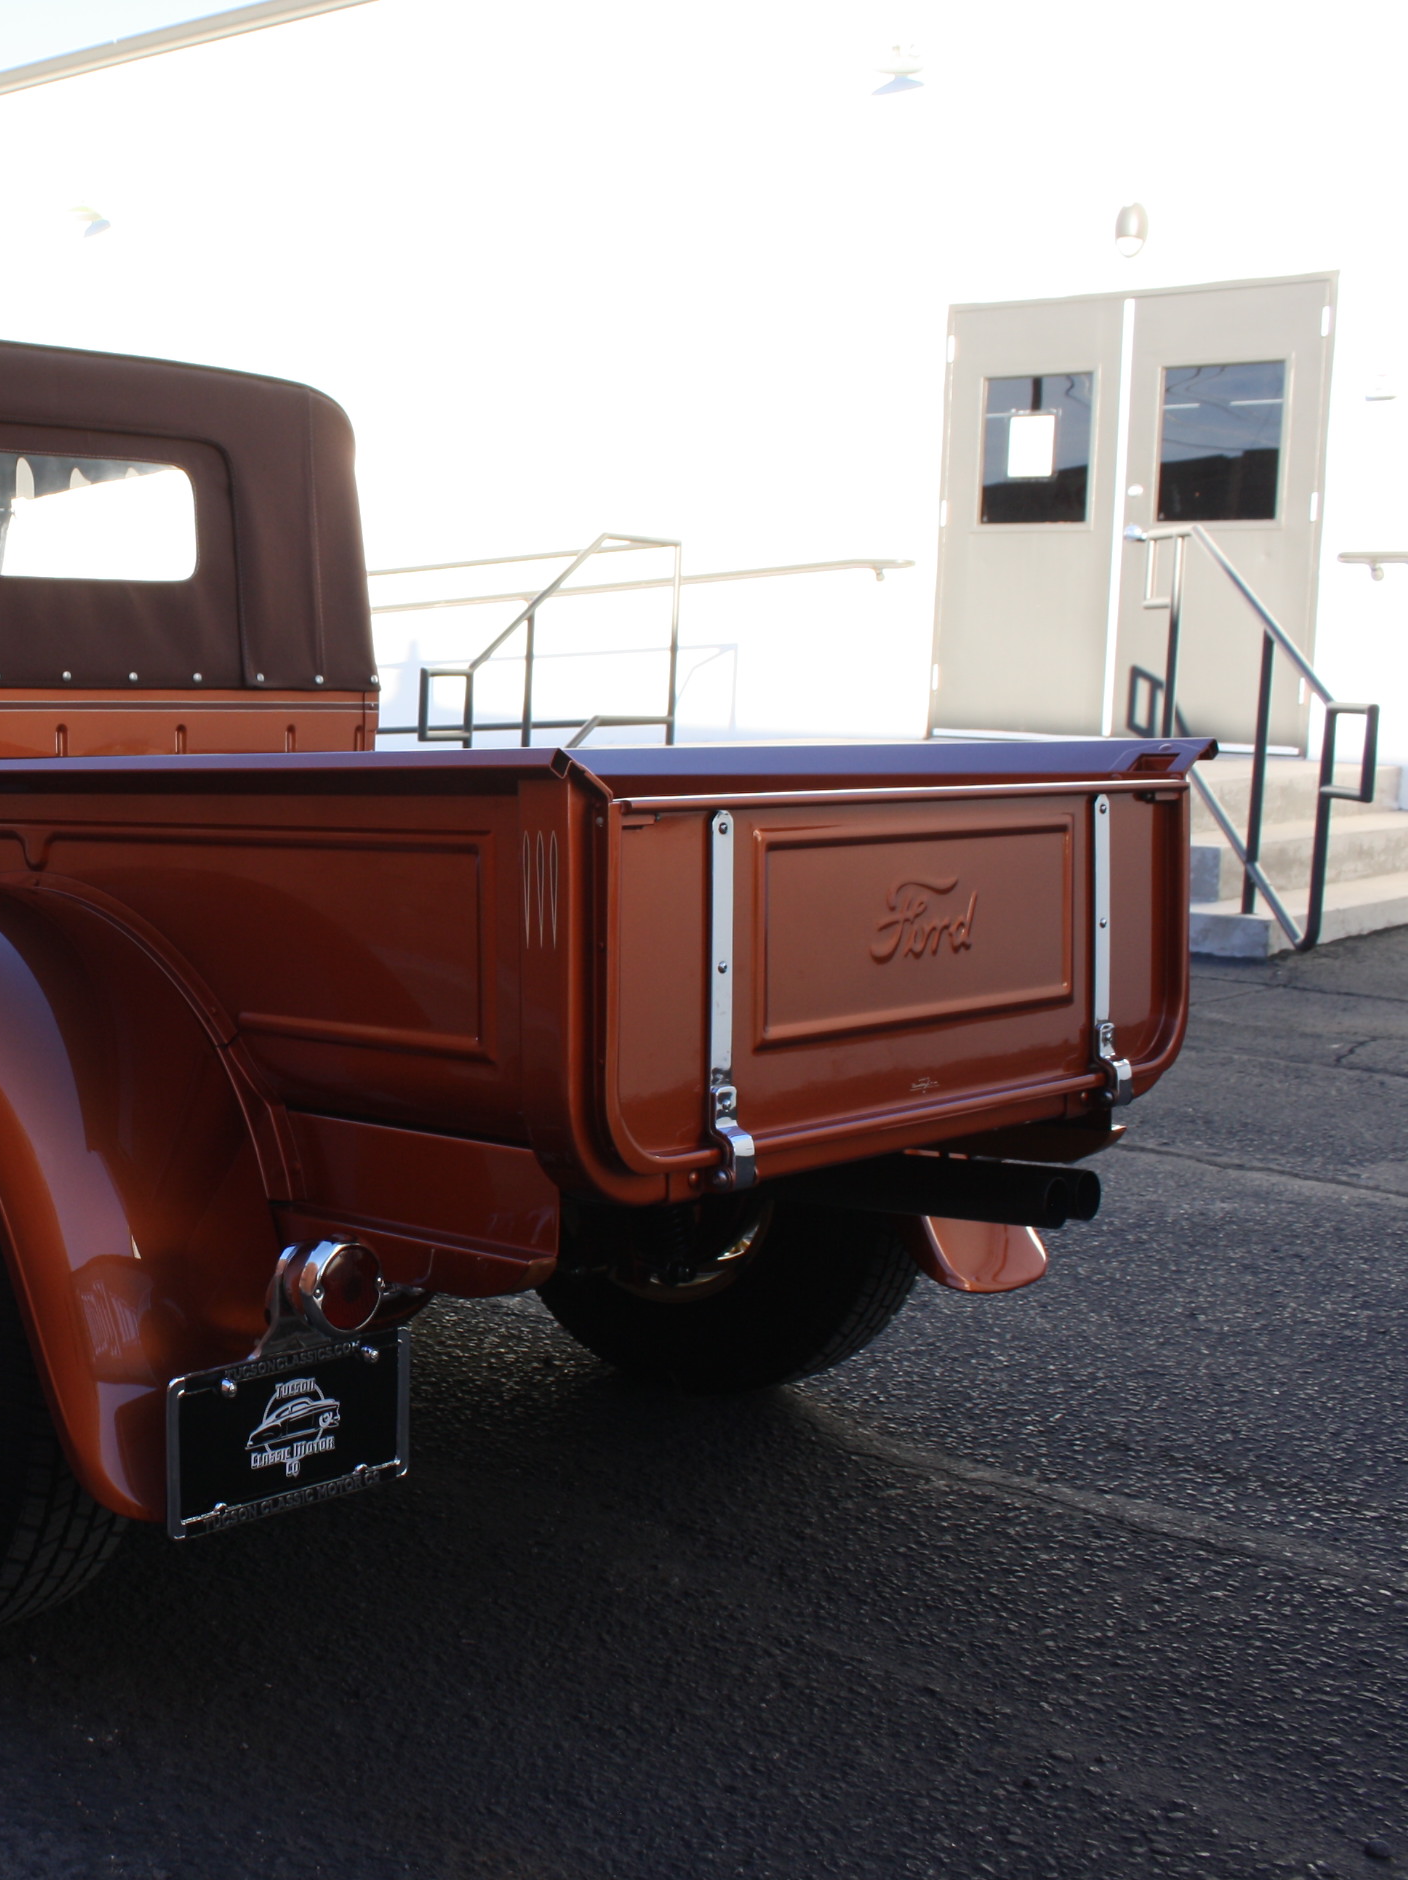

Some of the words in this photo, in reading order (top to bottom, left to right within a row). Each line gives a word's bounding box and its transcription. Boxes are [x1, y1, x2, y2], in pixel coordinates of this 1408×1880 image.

[870, 876, 978, 965] Ford
[203, 1503, 258, 1533] TUCSON
[260, 1487, 314, 1514] CLASSIC
[317, 1473, 364, 1501] MOTOR
[364, 1470, 382, 1486] CO
